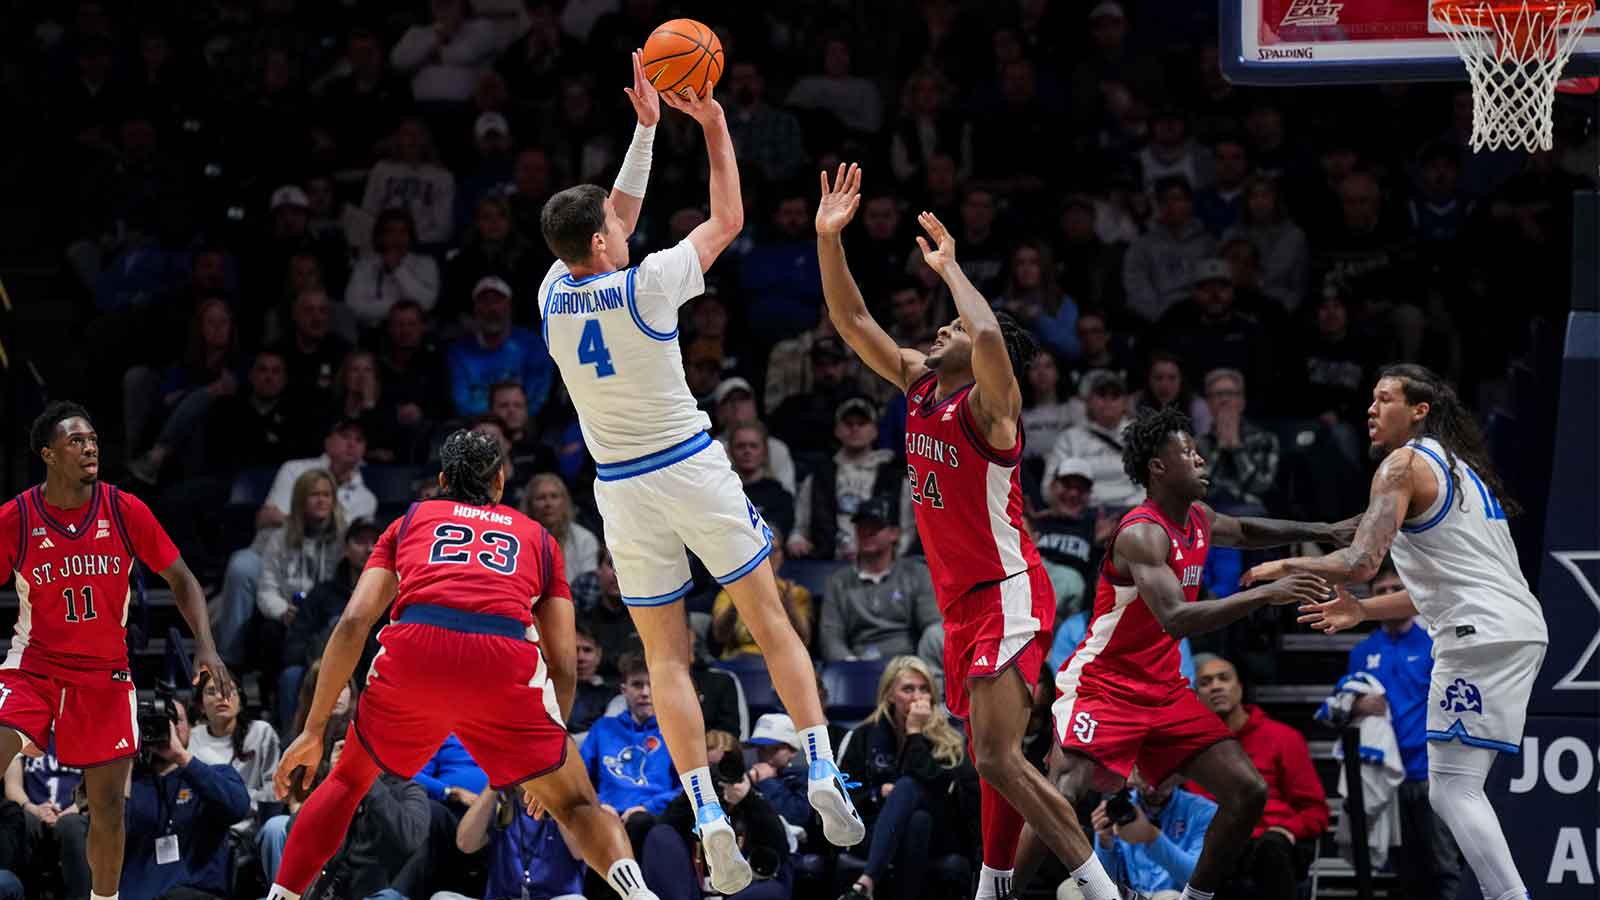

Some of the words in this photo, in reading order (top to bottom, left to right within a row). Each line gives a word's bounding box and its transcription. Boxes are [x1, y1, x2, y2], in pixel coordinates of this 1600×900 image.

[1288, 5, 1340, 17] EAST
[1257, 47, 1313, 61] SPALDING
[577, 319, 616, 378] 4
[907, 463, 945, 509] 24
[453, 504, 513, 526] HOPKINS
[32, 562, 56, 585] ST.
[60, 554, 121, 577] JOHN'S
[428, 522, 520, 576] 23
[62, 585, 98, 623] 11
[1508, 735, 1600, 794] JO
[1546, 826, 1600, 884] A
